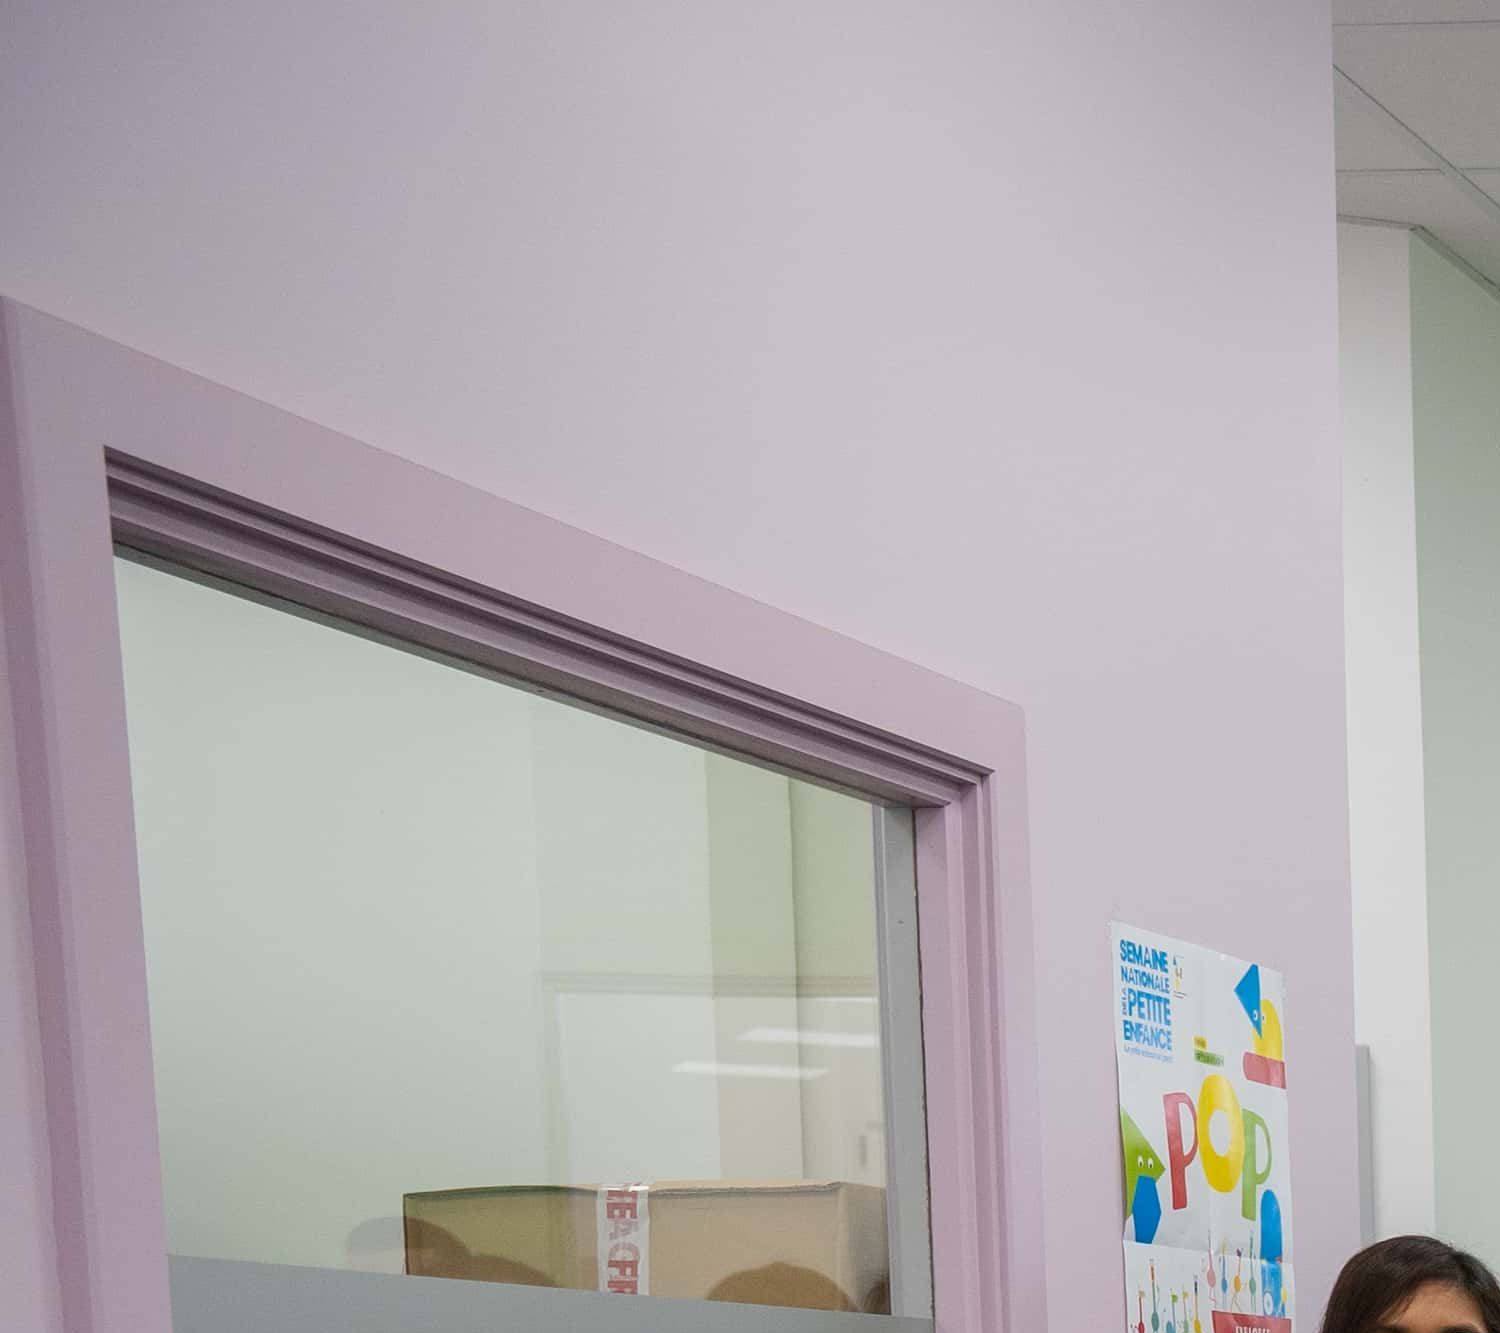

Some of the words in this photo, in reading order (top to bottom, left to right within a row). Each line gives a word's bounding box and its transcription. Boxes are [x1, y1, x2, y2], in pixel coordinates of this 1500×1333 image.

[1120, 939, 1168, 974] SEMAINE
[1120, 965, 1170, 994] NATIONALE
[1127, 987, 1171, 1026] PETITE
[1123, 1020, 1172, 1051] ENFANCE
